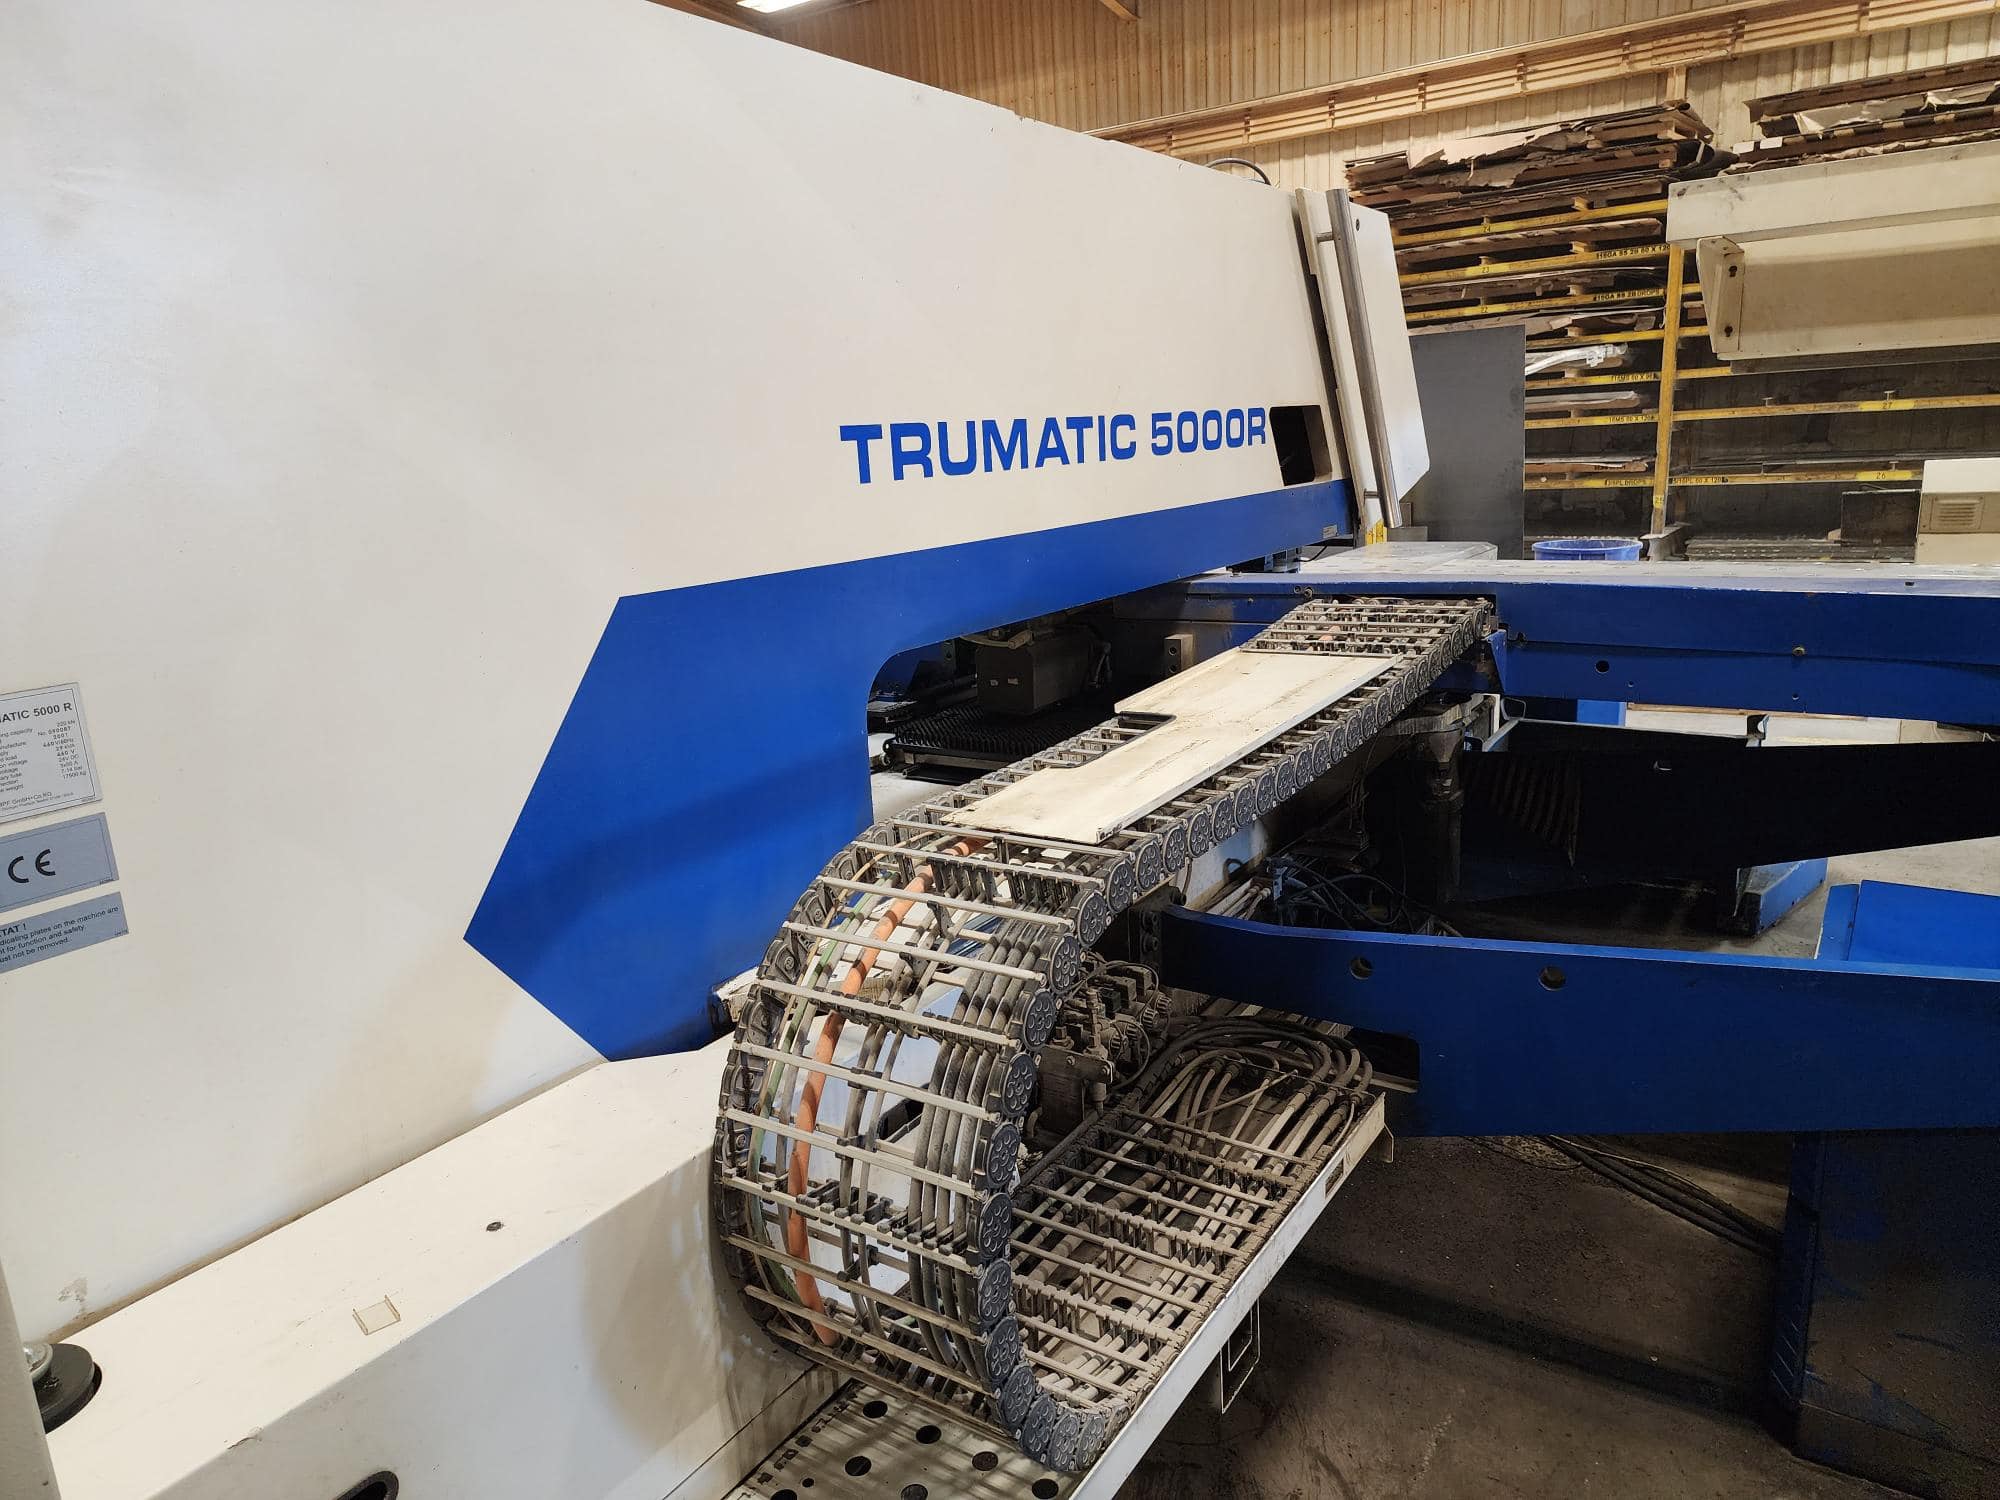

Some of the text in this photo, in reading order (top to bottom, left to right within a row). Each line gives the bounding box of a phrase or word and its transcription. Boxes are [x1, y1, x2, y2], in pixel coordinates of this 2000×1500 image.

[839, 407, 1267, 484] TRUMATIC 5000R
[0, 702, 73, 723] ATIC 5000 R
[8, 849, 56, 884] CE
[30, 926, 52, 940] plates
[64, 918, 77, 928] the
[77, 910, 106, 923] machine
[107, 906, 119, 914] are
[6, 943, 17, 953] for
[18, 935, 47, 949] function
[48, 929, 62, 940] and
[12, 949, 25, 960] not
[26, 945, 36, 955] be
